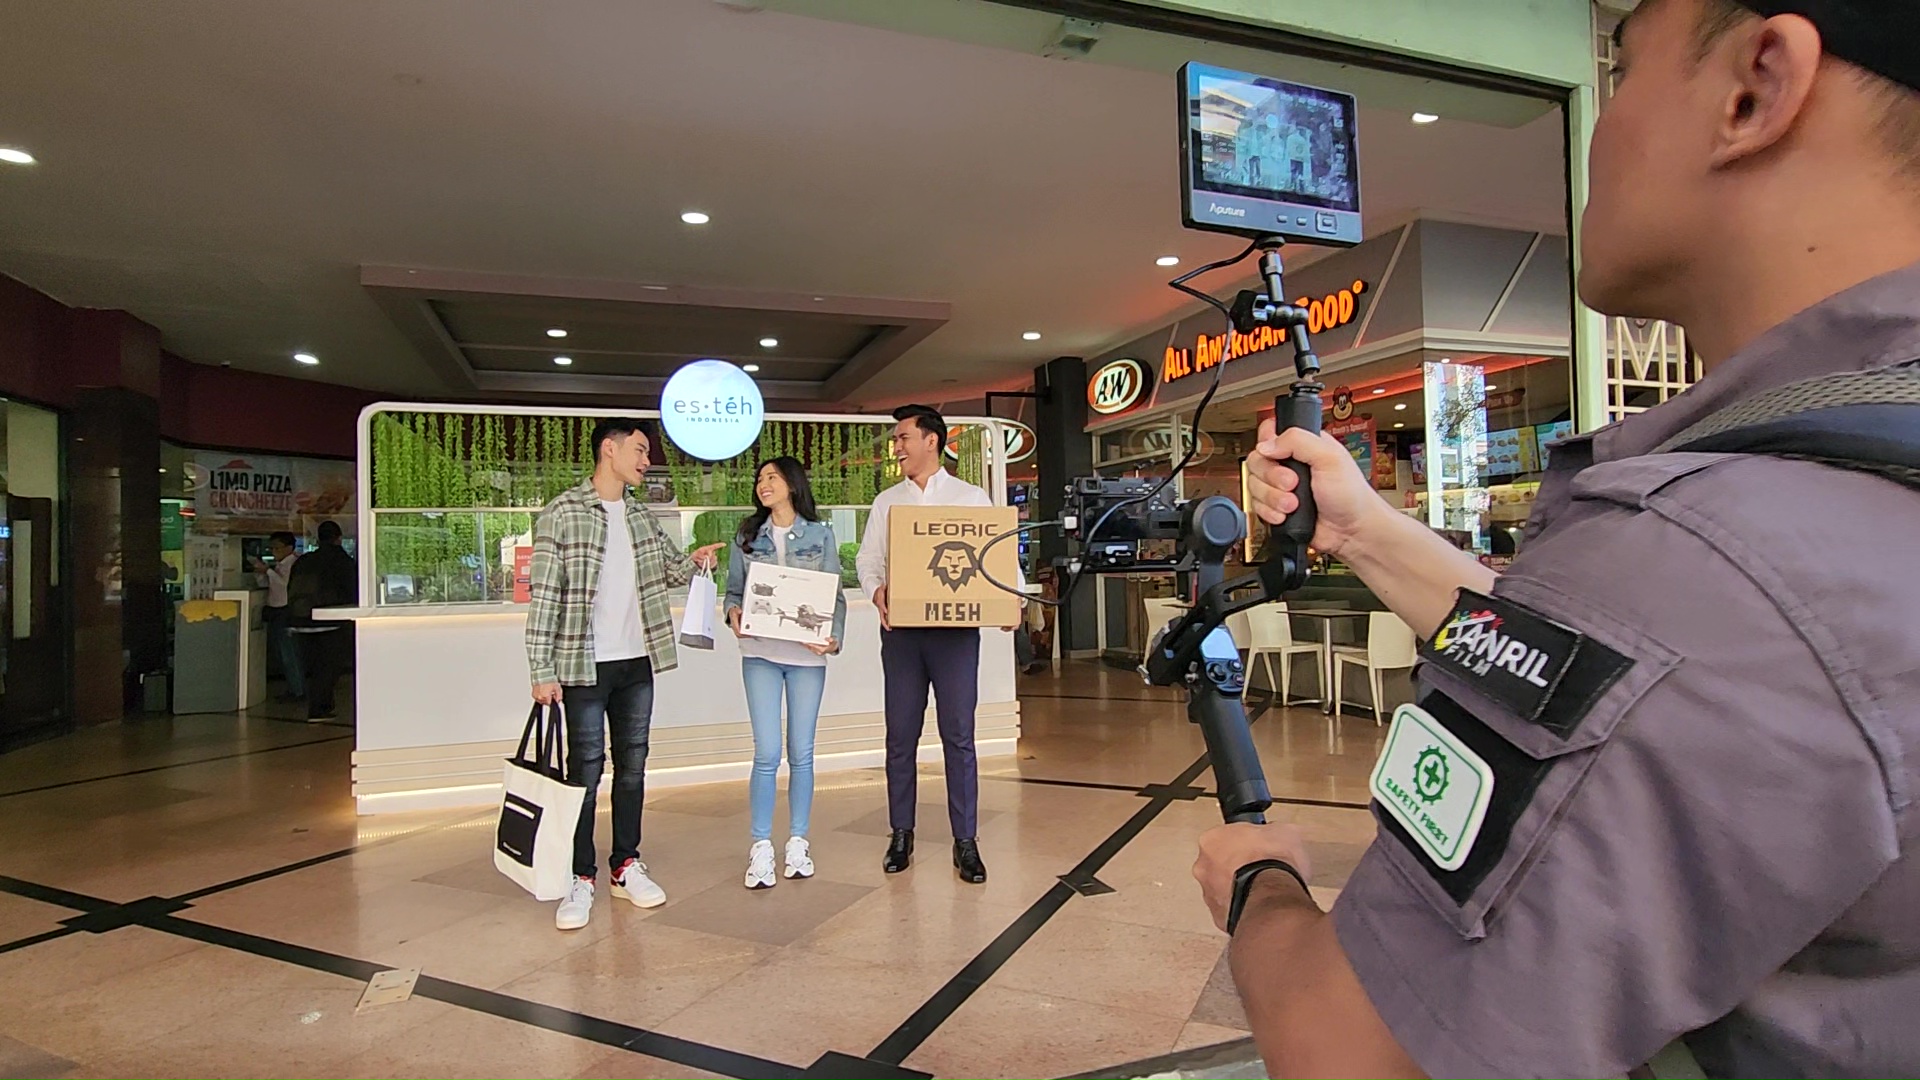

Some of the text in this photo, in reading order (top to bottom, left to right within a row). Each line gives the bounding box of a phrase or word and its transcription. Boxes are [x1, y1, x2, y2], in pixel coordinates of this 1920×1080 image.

[1294, 286, 1354, 334] OOD
[686, 416, 740, 424] INDONESIA
[253, 473, 293, 494] PIZZA
[913, 521, 999, 538] LEORIC
[925, 602, 981, 621] MESH
[1443, 644, 1494, 677] FILM
[1385, 777, 1422, 816] SAFETY
